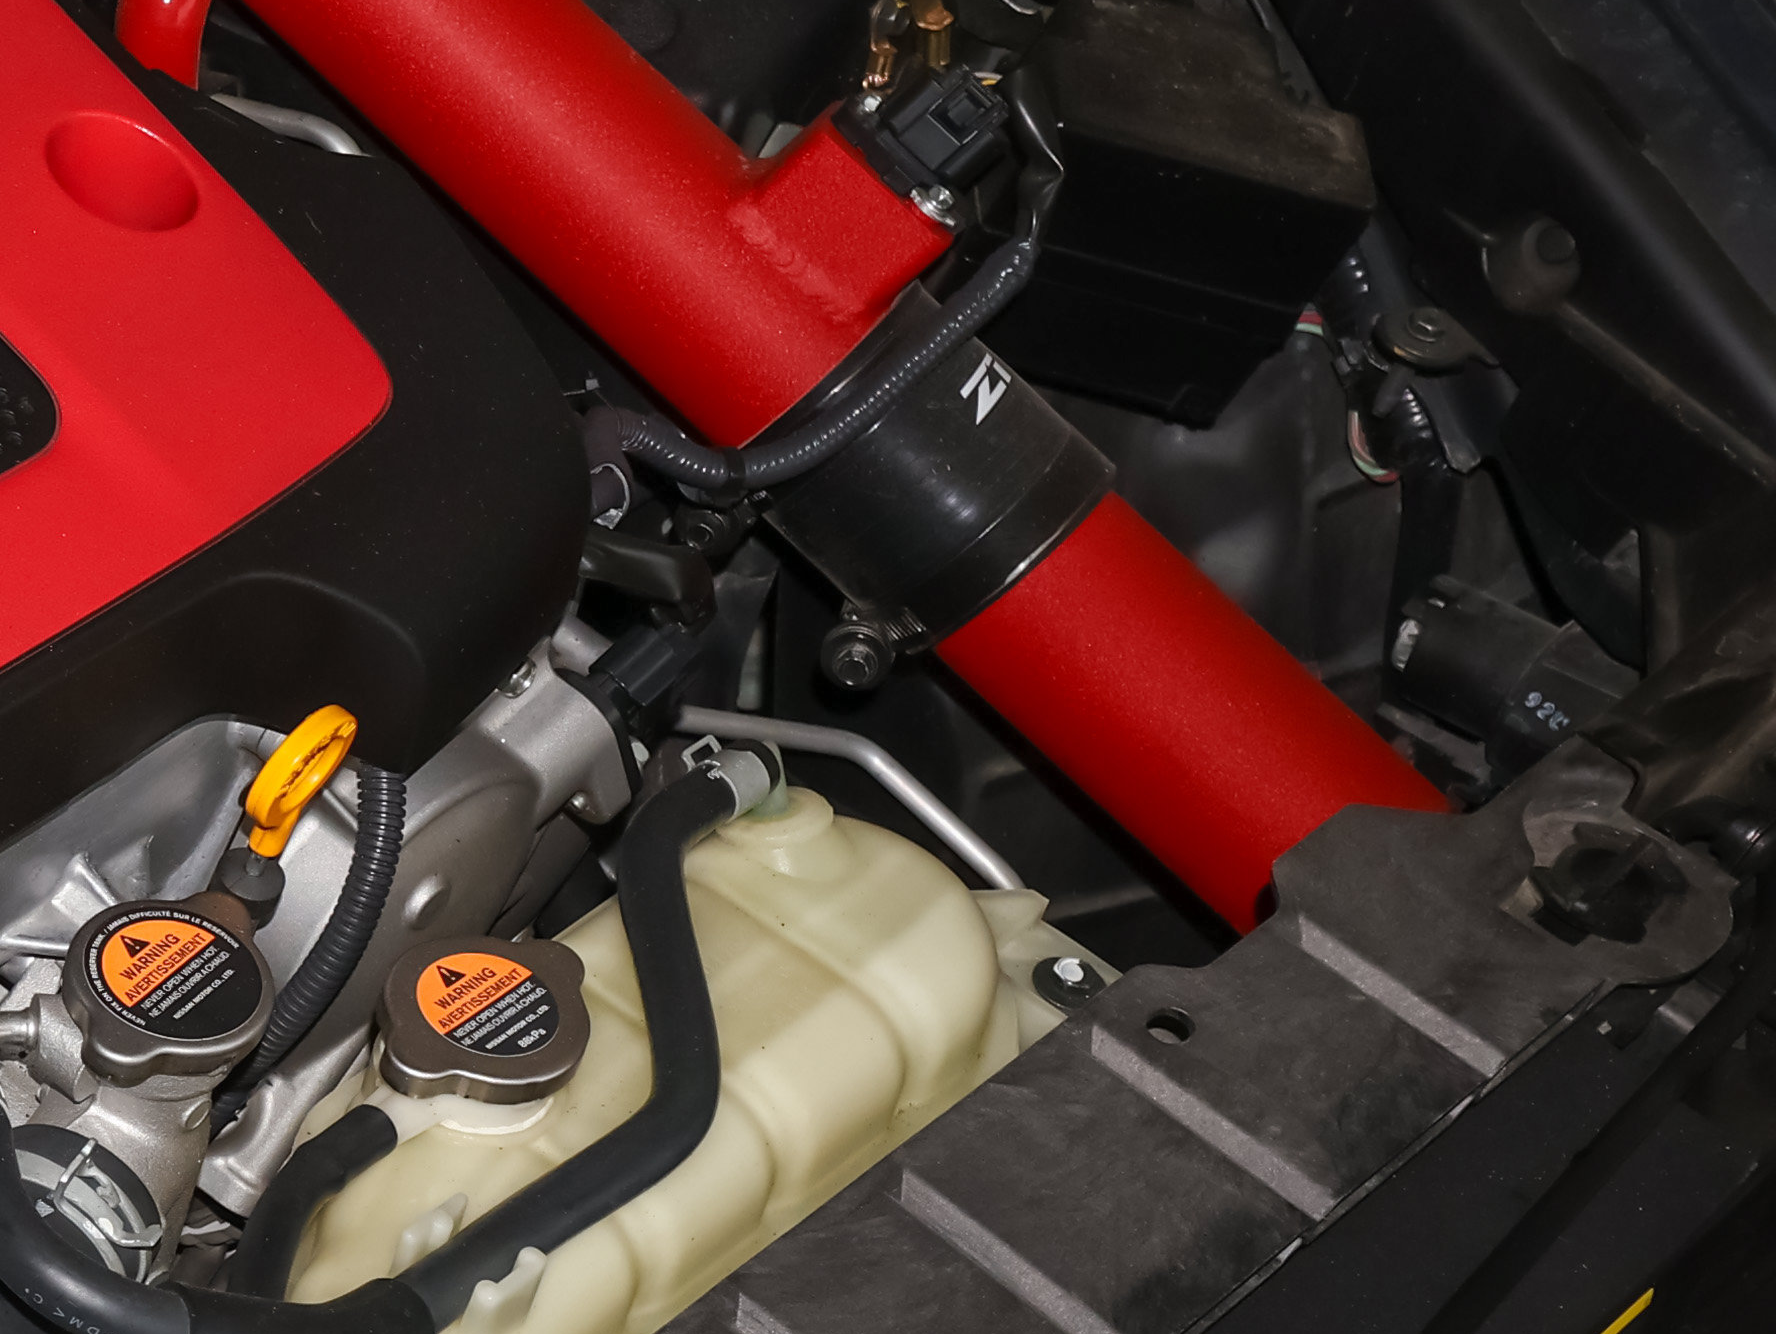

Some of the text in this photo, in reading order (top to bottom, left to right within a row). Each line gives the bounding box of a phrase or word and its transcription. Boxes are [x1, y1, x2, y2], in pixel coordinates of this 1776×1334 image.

[173, 912, 189, 920] SUR
[119, 934, 181, 980] WARNING
[124, 932, 207, 1002] AVERTISSEMENT
[141, 989, 165, 1009] NEVER
[163, 975, 184, 992] OPEN
[182, 958, 205, 977] WHEN
[159, 991, 181, 1014] JAMAIS
[173, 1001, 195, 1020] NISSAN
[193, 987, 214, 1003] MOTOR
[434, 967, 497, 1009] WARNING
[438, 968, 523, 1029] AVERTISSEMENT
[452, 1020, 477, 1038] NEVER
[476, 1007, 498, 1023] OPEN
[495, 993, 520, 1010] WHEN
[472, 1024, 496, 1042] JAMAIS
[485, 1033, 508, 1049] NISSAN
[506, 1020, 528, 1035] MOTOR
